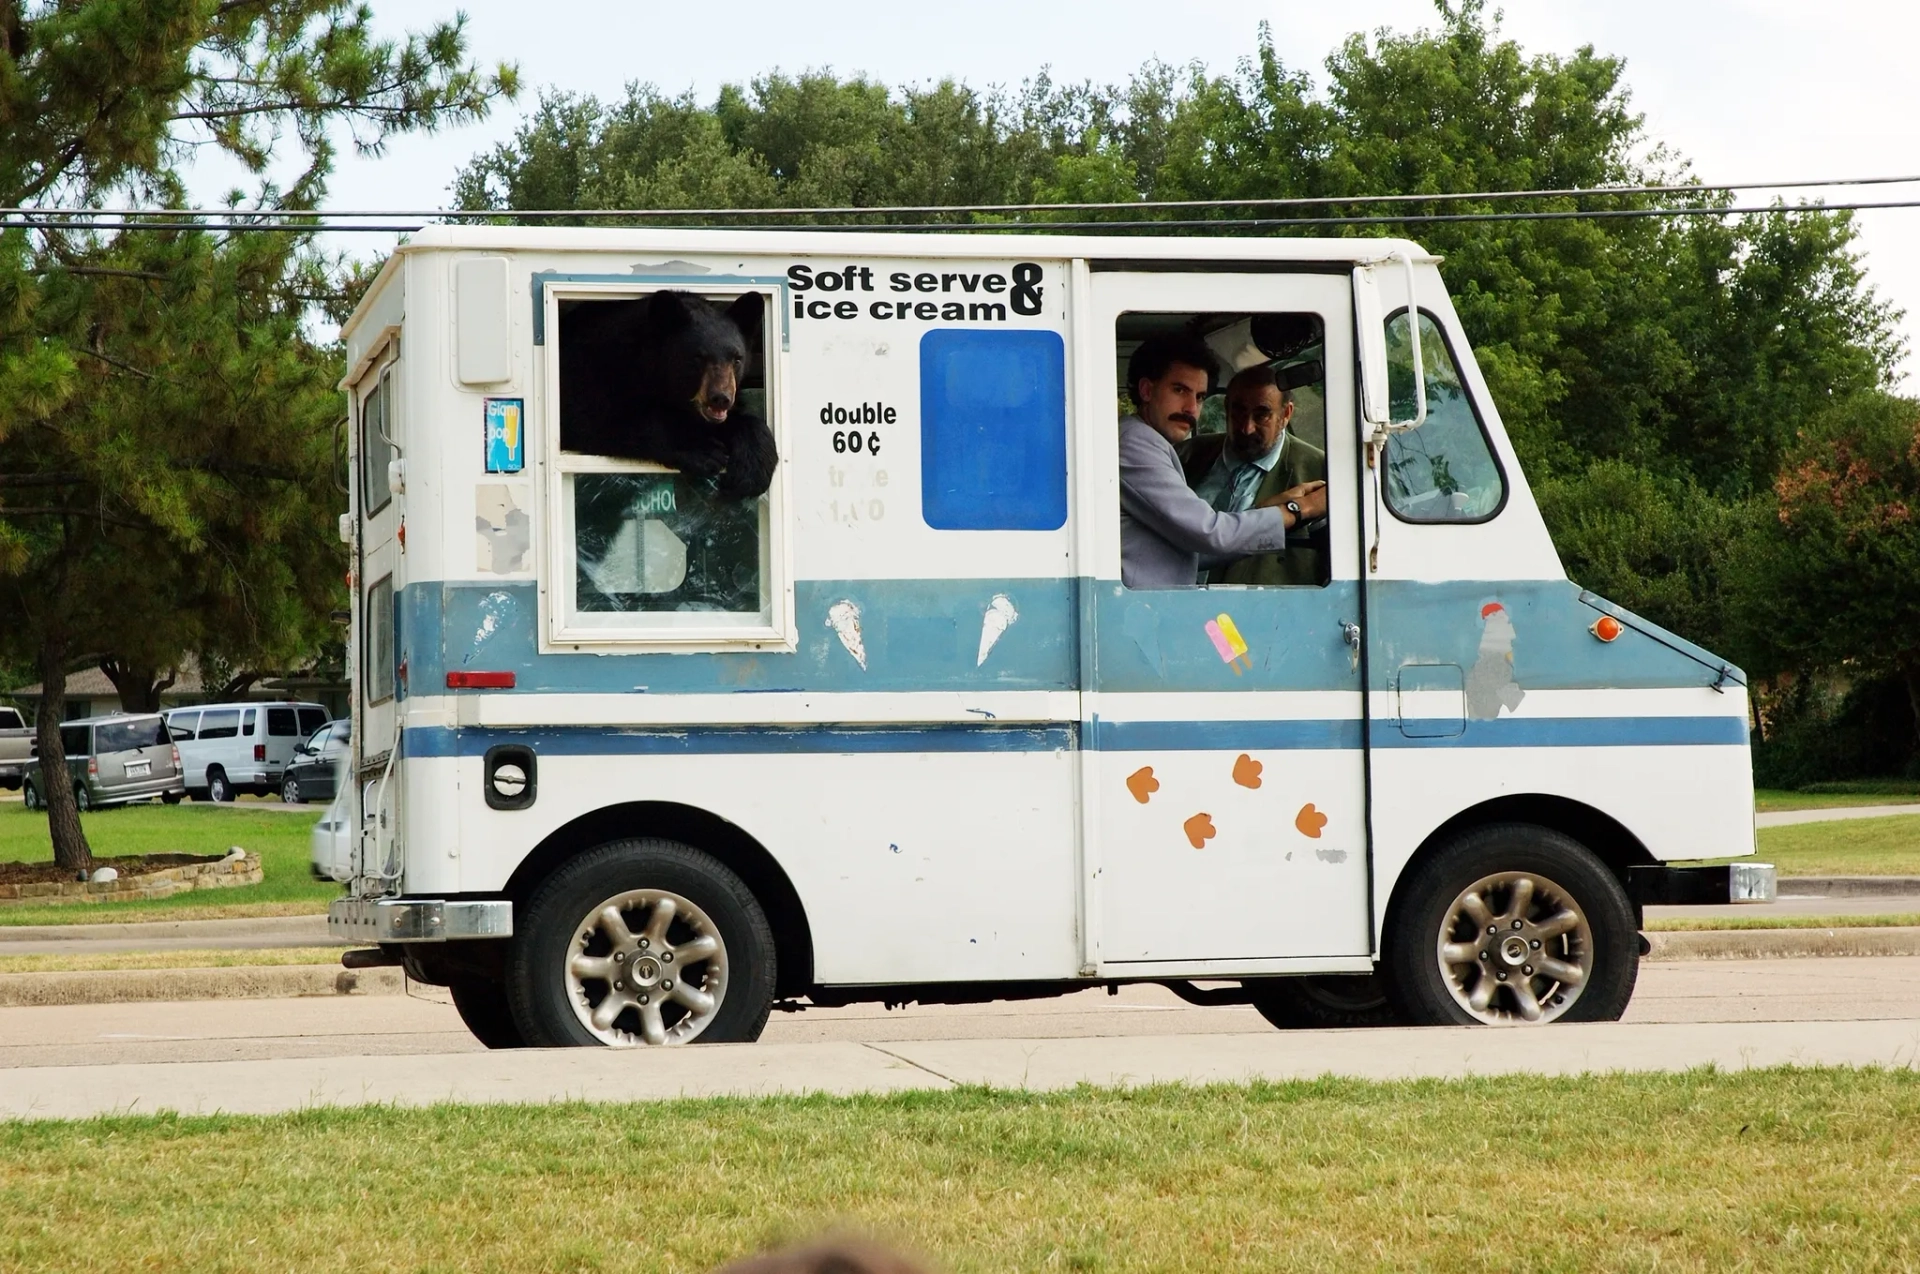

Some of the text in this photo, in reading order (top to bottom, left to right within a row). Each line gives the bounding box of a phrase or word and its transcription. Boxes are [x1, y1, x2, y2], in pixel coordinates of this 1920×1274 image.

[787, 262, 1043, 316] Soft serve &
[794, 295, 1007, 321] ice cream
[488, 401, 517, 417] Giant
[820, 402, 897, 425] double
[489, 427, 510, 443] pop
[832, 431, 881, 456] 60¢
